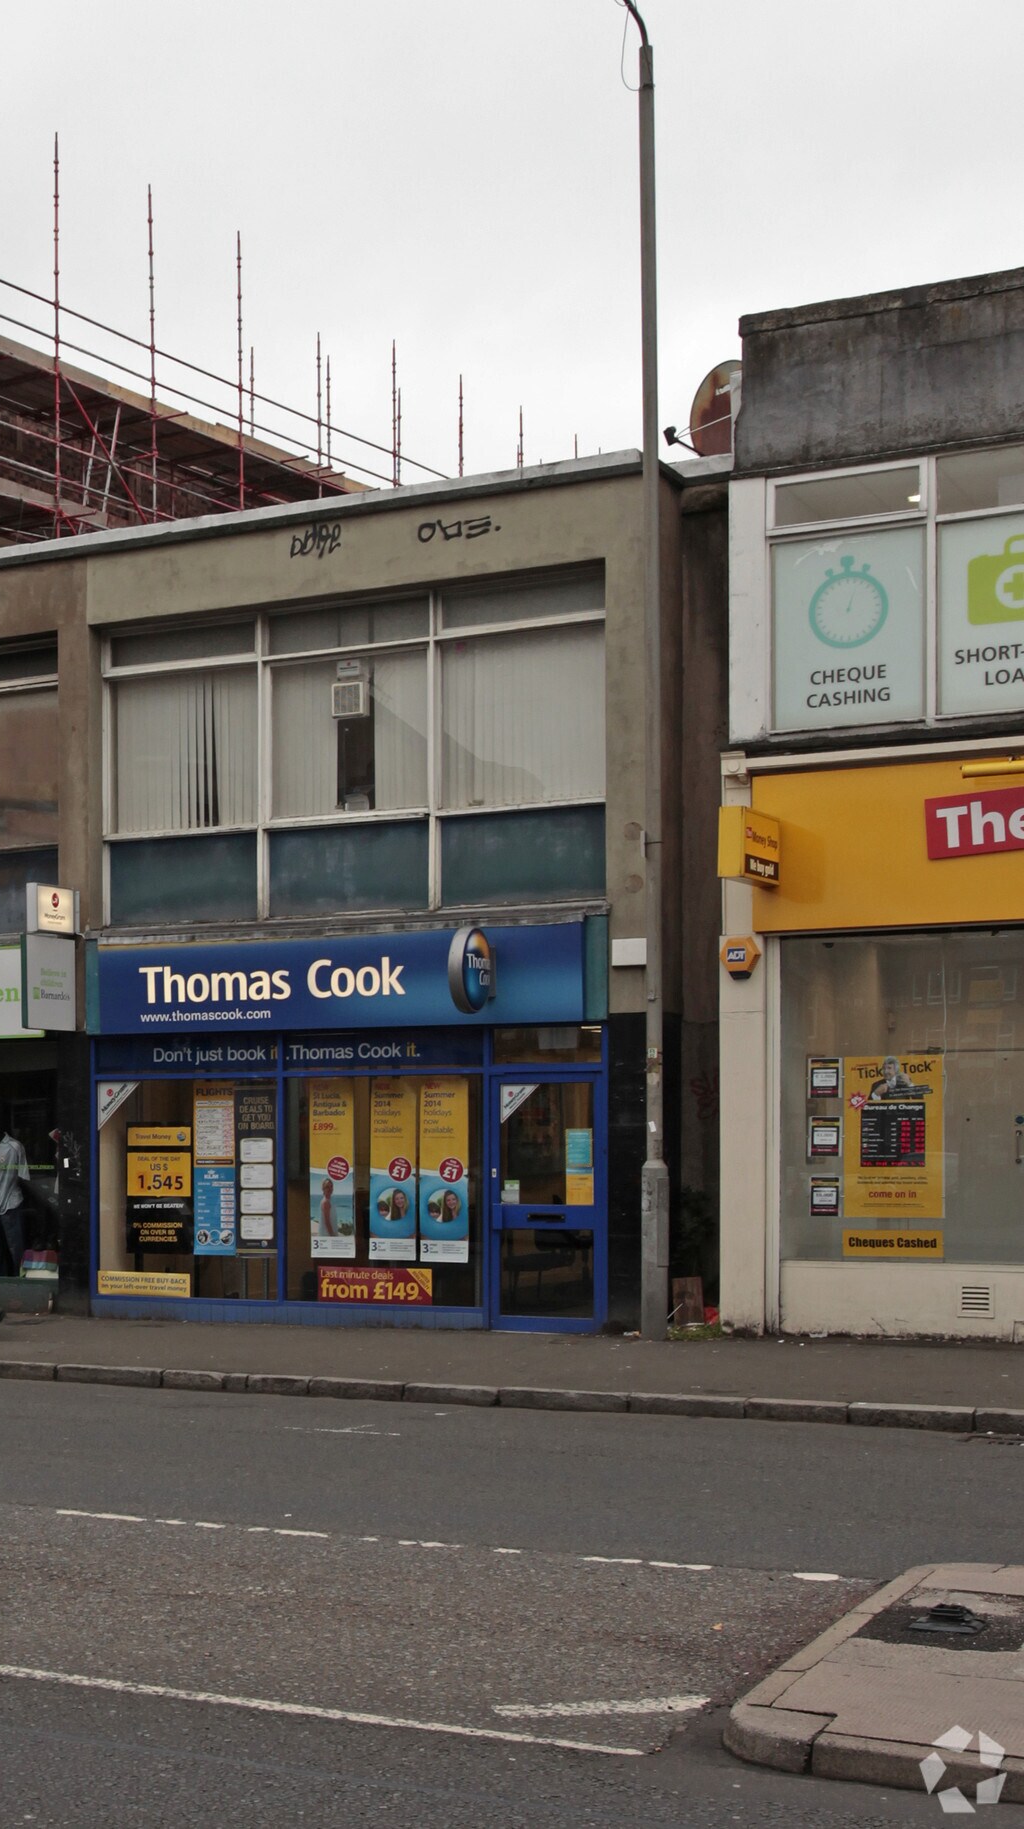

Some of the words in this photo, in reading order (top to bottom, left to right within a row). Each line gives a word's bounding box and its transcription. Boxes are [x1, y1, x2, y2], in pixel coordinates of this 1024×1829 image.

[953, 643, 1024, 665] SHORT-
[809, 663, 887, 685] CHEQUE
[806, 686, 891, 708] CASHING
[935, 800, 1024, 849] The
[752, 831, 767, 848] Money
[767, 836, 778, 851] Shop
[749, 858, 757, 871] We
[757, 860, 765, 876] buy
[765, 863, 775, 877] gold
[44, 912, 66, 921] MoneyGram
[727, 949, 745, 961] ADT
[138, 965, 292, 1004] Thomas
[306, 956, 406, 999] Cook
[139, 1009, 272, 1023] www.thomascook.com
[152, 1048, 193, 1063] Don't
[195, 1048, 223, 1065] just
[227, 1046, 266, 1062] book
[357, 1042, 402, 1058] Cook
[405, 1041, 421, 1058] it.
[424, 1082, 441, 1090] NEW
[195, 1087, 234, 1097] FLIGHTS
[374, 1091, 404, 1099] Summer
[423, 1091, 456, 1099] Summer
[242, 1096, 270, 1105] CRUISE
[312, 1101, 343, 1109] Antigua
[239, 1105, 264, 1114] DEALS
[264, 1104, 274, 1113] TO
[312, 1109, 346, 1117] Barbados
[374, 1109, 401, 1117] holidays
[423, 1109, 452, 1117] holidays
[241, 1113, 256, 1122] GET
[257, 1113, 272, 1122] YOU
[237, 1122, 249, 1130] ON
[250, 1122, 275, 1130] BOARD
[312, 1122, 334, 1131] £899
[374, 1126, 402, 1134] available
[423, 1126, 453, 1134] available
[134, 1133, 152, 1141] Travel
[151, 1133, 172, 1142] Money
[149, 1163, 162, 1171] US
[162, 1163, 169, 1172] $
[391, 1166, 406, 1179] £1
[442, 1167, 458, 1180] £1
[137, 1174, 184, 1191] 1.545
[868, 1191, 893, 1199] come
[894, 1191, 905, 1199] on
[908, 1189, 917, 1199] in
[138, 1235, 178, 1243] CURRENCIES
[848, 1236, 895, 1249] Cheques
[896, 1237, 938, 1249] Cashed
[313, 1239, 320, 1250] 3
[371, 1241, 378, 1251] 3
[422, 1243, 429, 1254] 3
[101, 1275, 140, 1284] COMMISSION
[320, 1269, 336, 1279] Last
[338, 1271, 370, 1279] minute
[371, 1270, 394, 1280] deals
[149, 1284, 166, 1292] travel
[166, 1285, 187, 1293] money
[320, 1279, 369, 1299] from
[372, 1281, 420, 1301] £149
